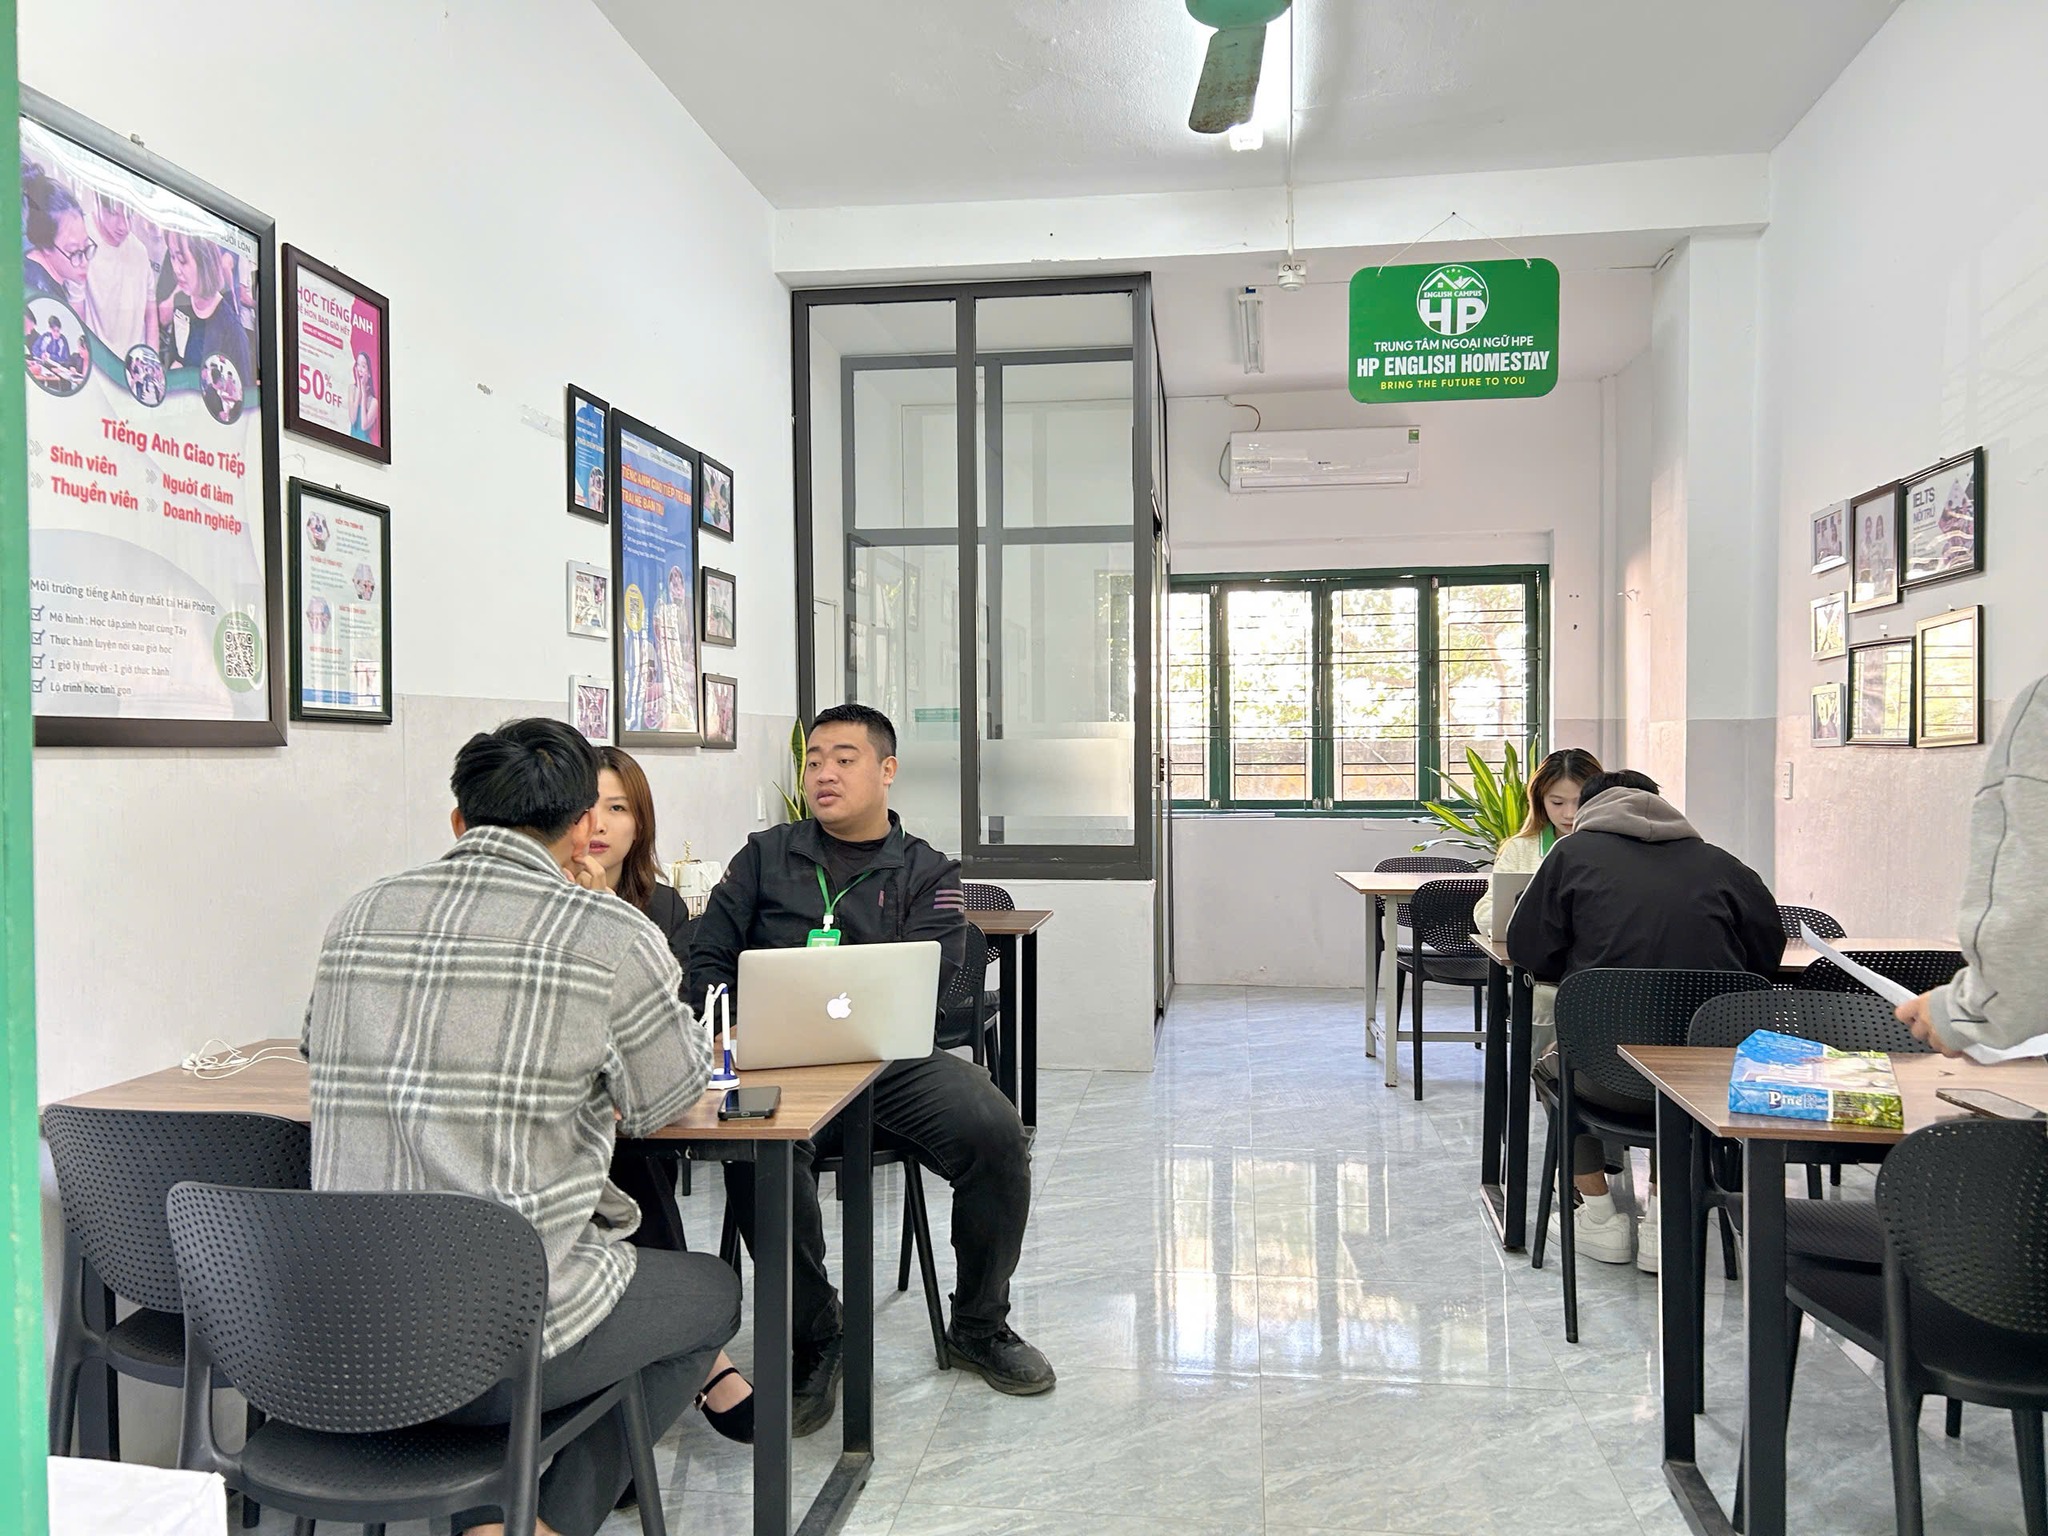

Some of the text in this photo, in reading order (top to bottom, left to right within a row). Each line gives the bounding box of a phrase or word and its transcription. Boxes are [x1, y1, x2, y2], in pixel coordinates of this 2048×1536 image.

[320, 297, 350, 323] TIẾNG
[352, 313, 373, 336] ANH
[1420, 298, 1486, 334] HP
[1374, 334, 1534, 352] TRUNG TÂM NGOẠI NGỮ HPE
[1357, 351, 1550, 378] HP ENGLISH HOMESTAY
[1380, 376, 1526, 390] BRING THE FUTURE TO YOU
[325, 391, 342, 408] OFF
[50, 446, 117, 477] Sinh viên
[102, 418, 245, 478] Tiếng Anh Giao Tiếp
[51, 476, 139, 510] Thuyền viên
[162, 473, 233, 505] Người đi làm
[164, 501, 242, 535] Doanh nghiệp
[30, 579, 49, 592] Môi
[52, 583, 83, 598] trường
[86, 586, 108, 601] tiếng
[111, 590, 127, 601] Anh
[146, 595, 164, 607] nhất
[192, 601, 215, 615] Phòng
[50, 660, 56, 669] 1
[114, 664, 119, 673] 1
[84, 684, 99, 695] học
